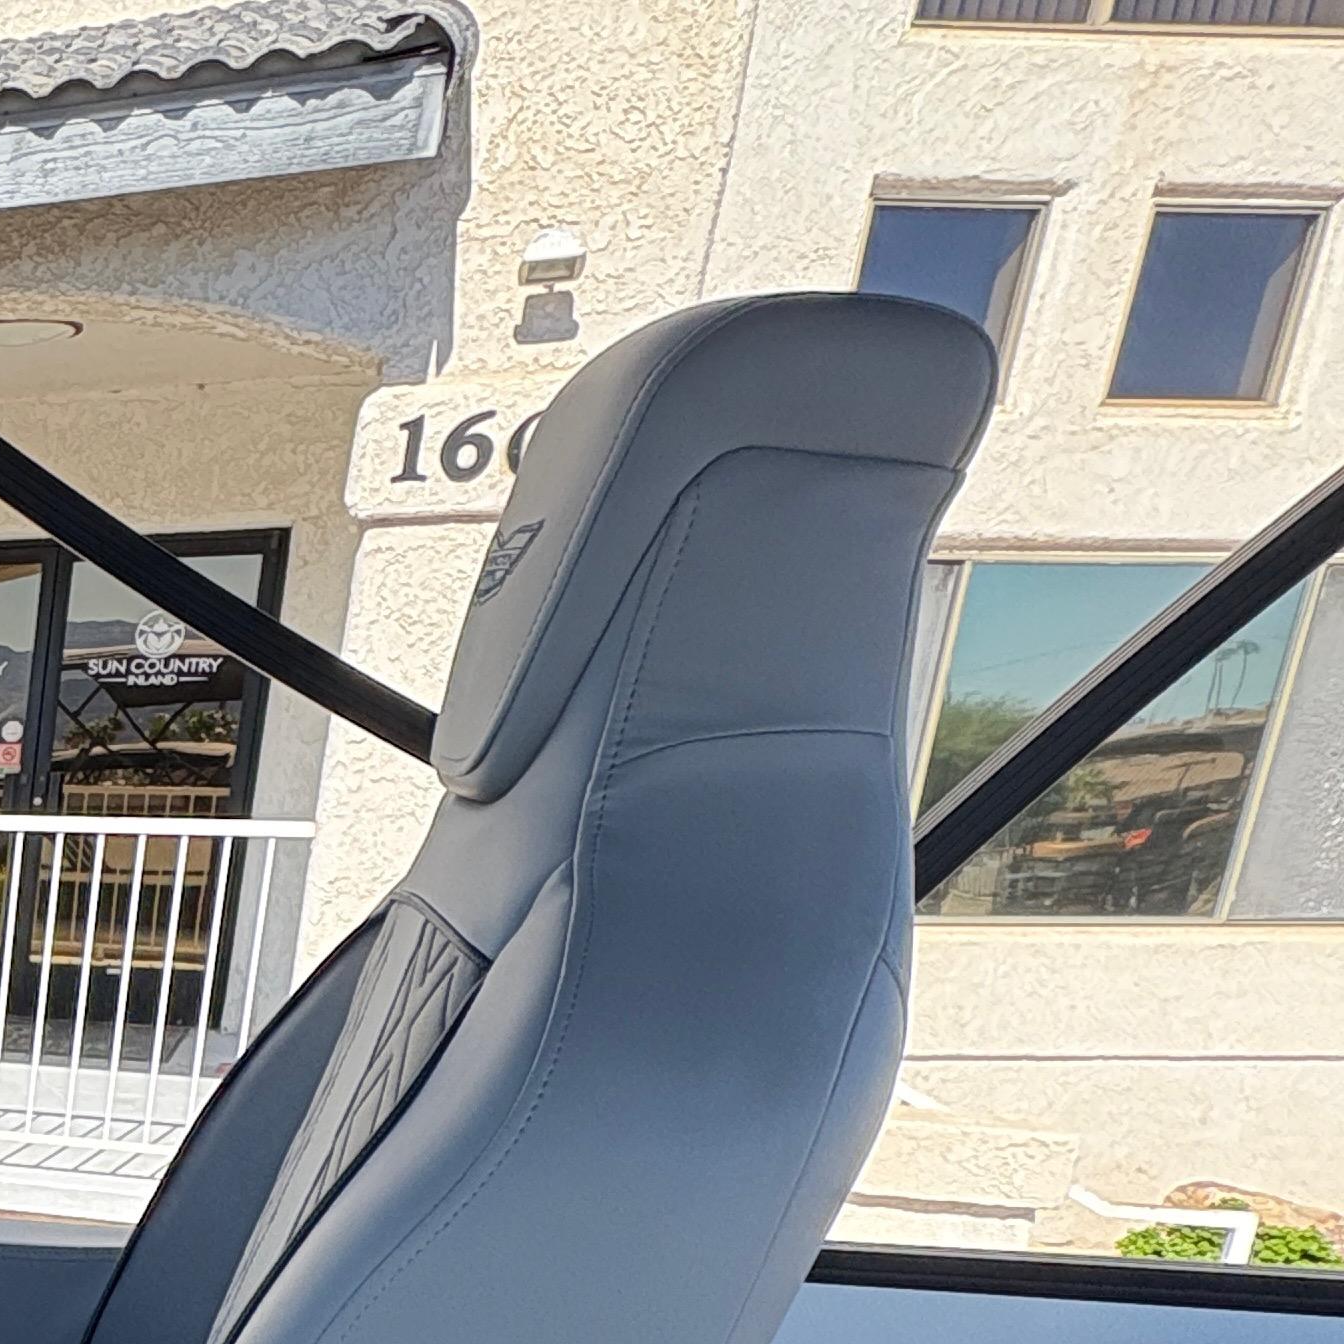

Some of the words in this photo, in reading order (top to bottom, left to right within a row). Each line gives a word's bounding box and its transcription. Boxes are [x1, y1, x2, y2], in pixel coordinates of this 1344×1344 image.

[87, 658, 128, 675] SUN
[130, 656, 224, 674] COUNTRY
[127, 673, 178, 686] INLAND
